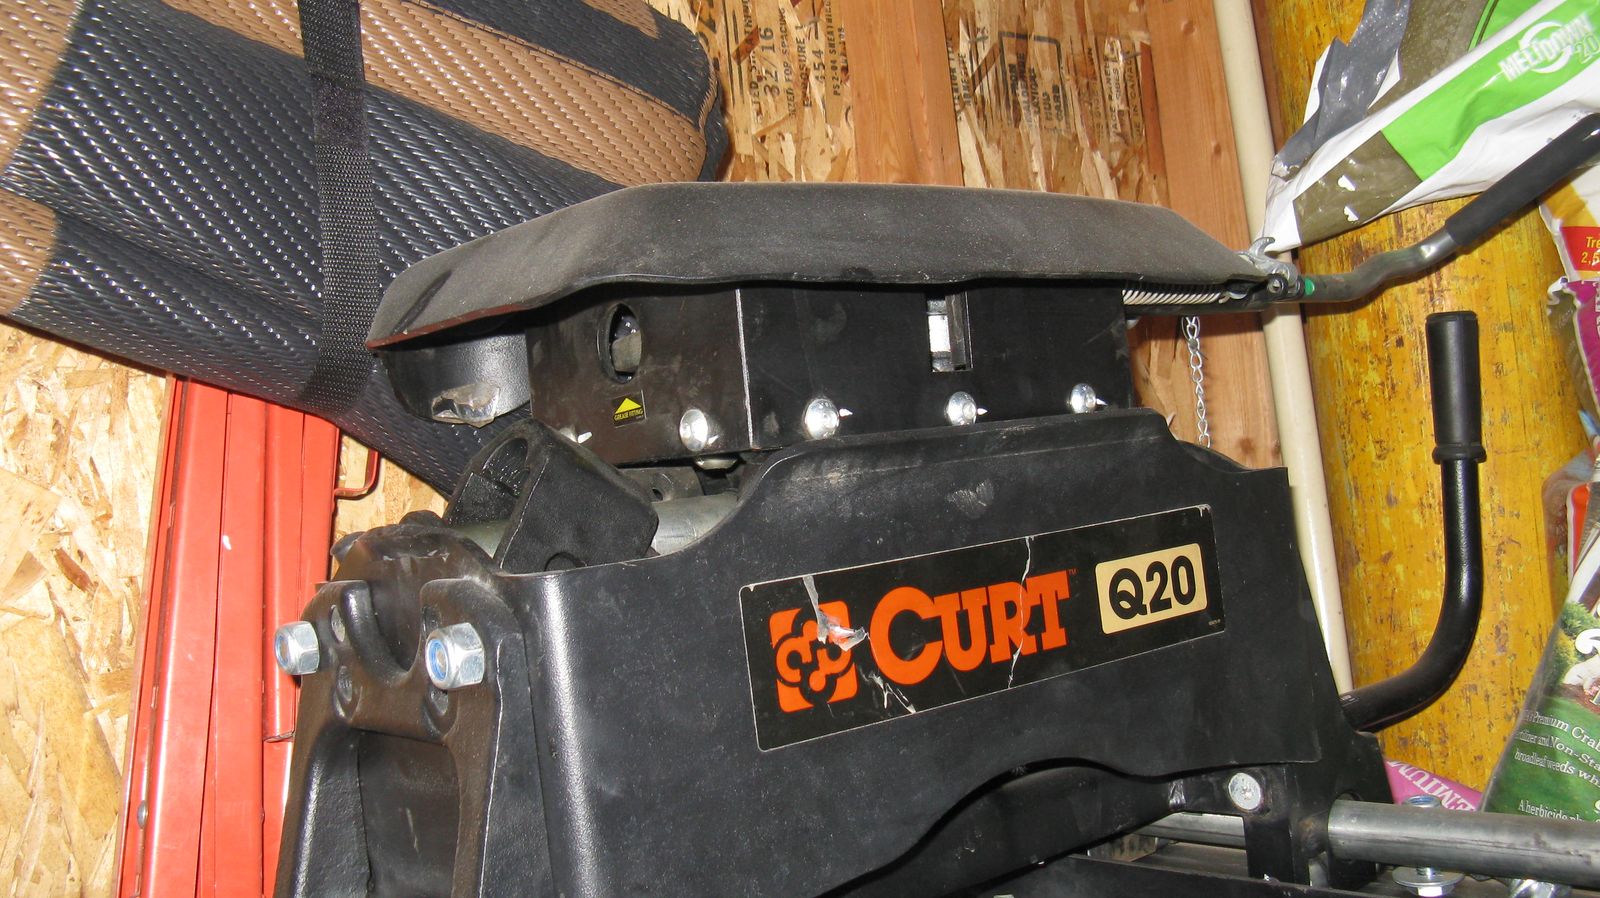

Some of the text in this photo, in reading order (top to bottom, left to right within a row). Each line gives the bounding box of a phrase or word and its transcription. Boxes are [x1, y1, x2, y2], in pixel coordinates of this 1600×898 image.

[759, 27, 780, 97] 32/16
[1498, 12, 1593, 82] MELTDOWN
[1109, 555, 1198, 620] Q20
[870, 570, 1071, 685] CURT
[1532, 711, 1569, 733] Premium
[1515, 748, 1547, 769] broadleaf
[1547, 761, 1576, 775] weeds
[1525, 800, 1568, 820] herbicide
